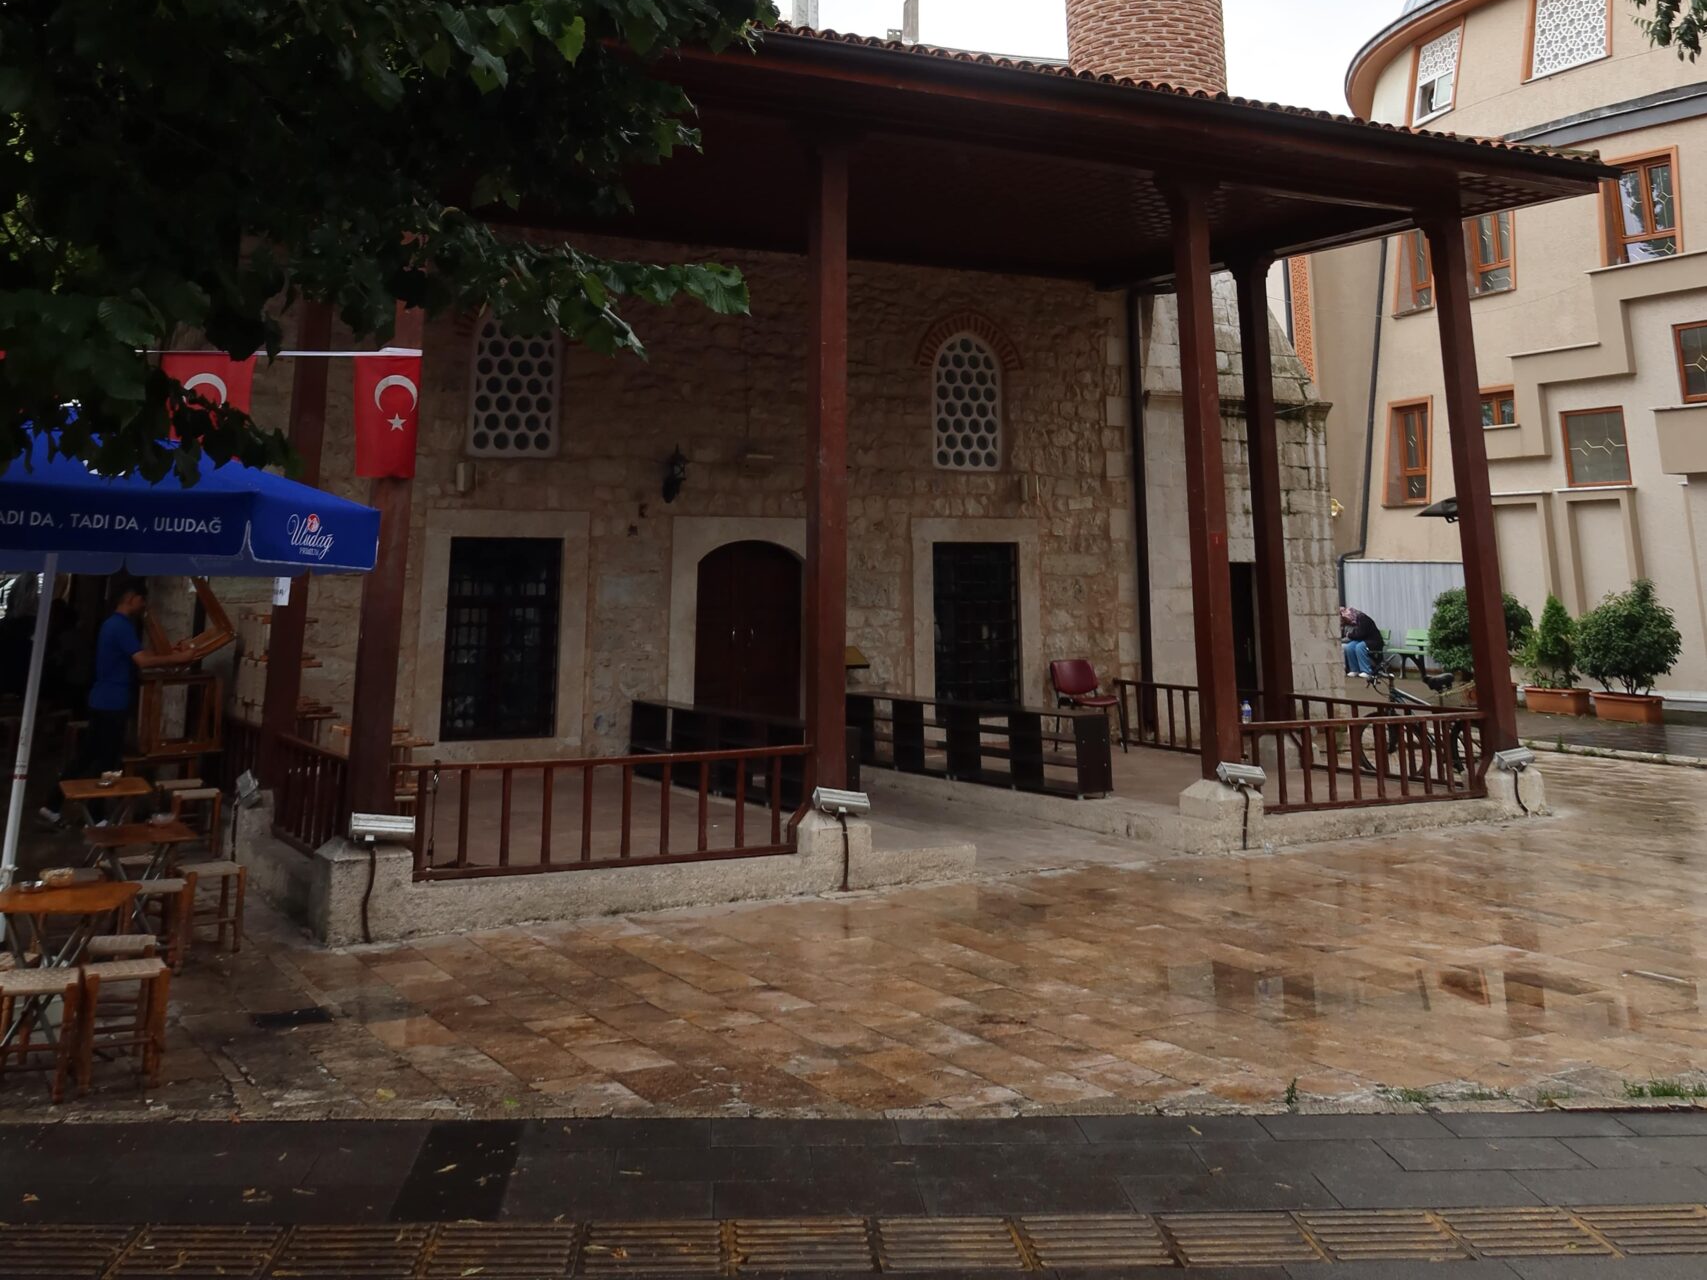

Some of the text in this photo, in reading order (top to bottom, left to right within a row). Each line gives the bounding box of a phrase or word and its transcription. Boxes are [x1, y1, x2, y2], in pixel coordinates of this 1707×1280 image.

[69, 513, 110, 529] TADI
[154, 516, 222, 534] ULUDAĞ
[287, 513, 335, 561] Uludağ
